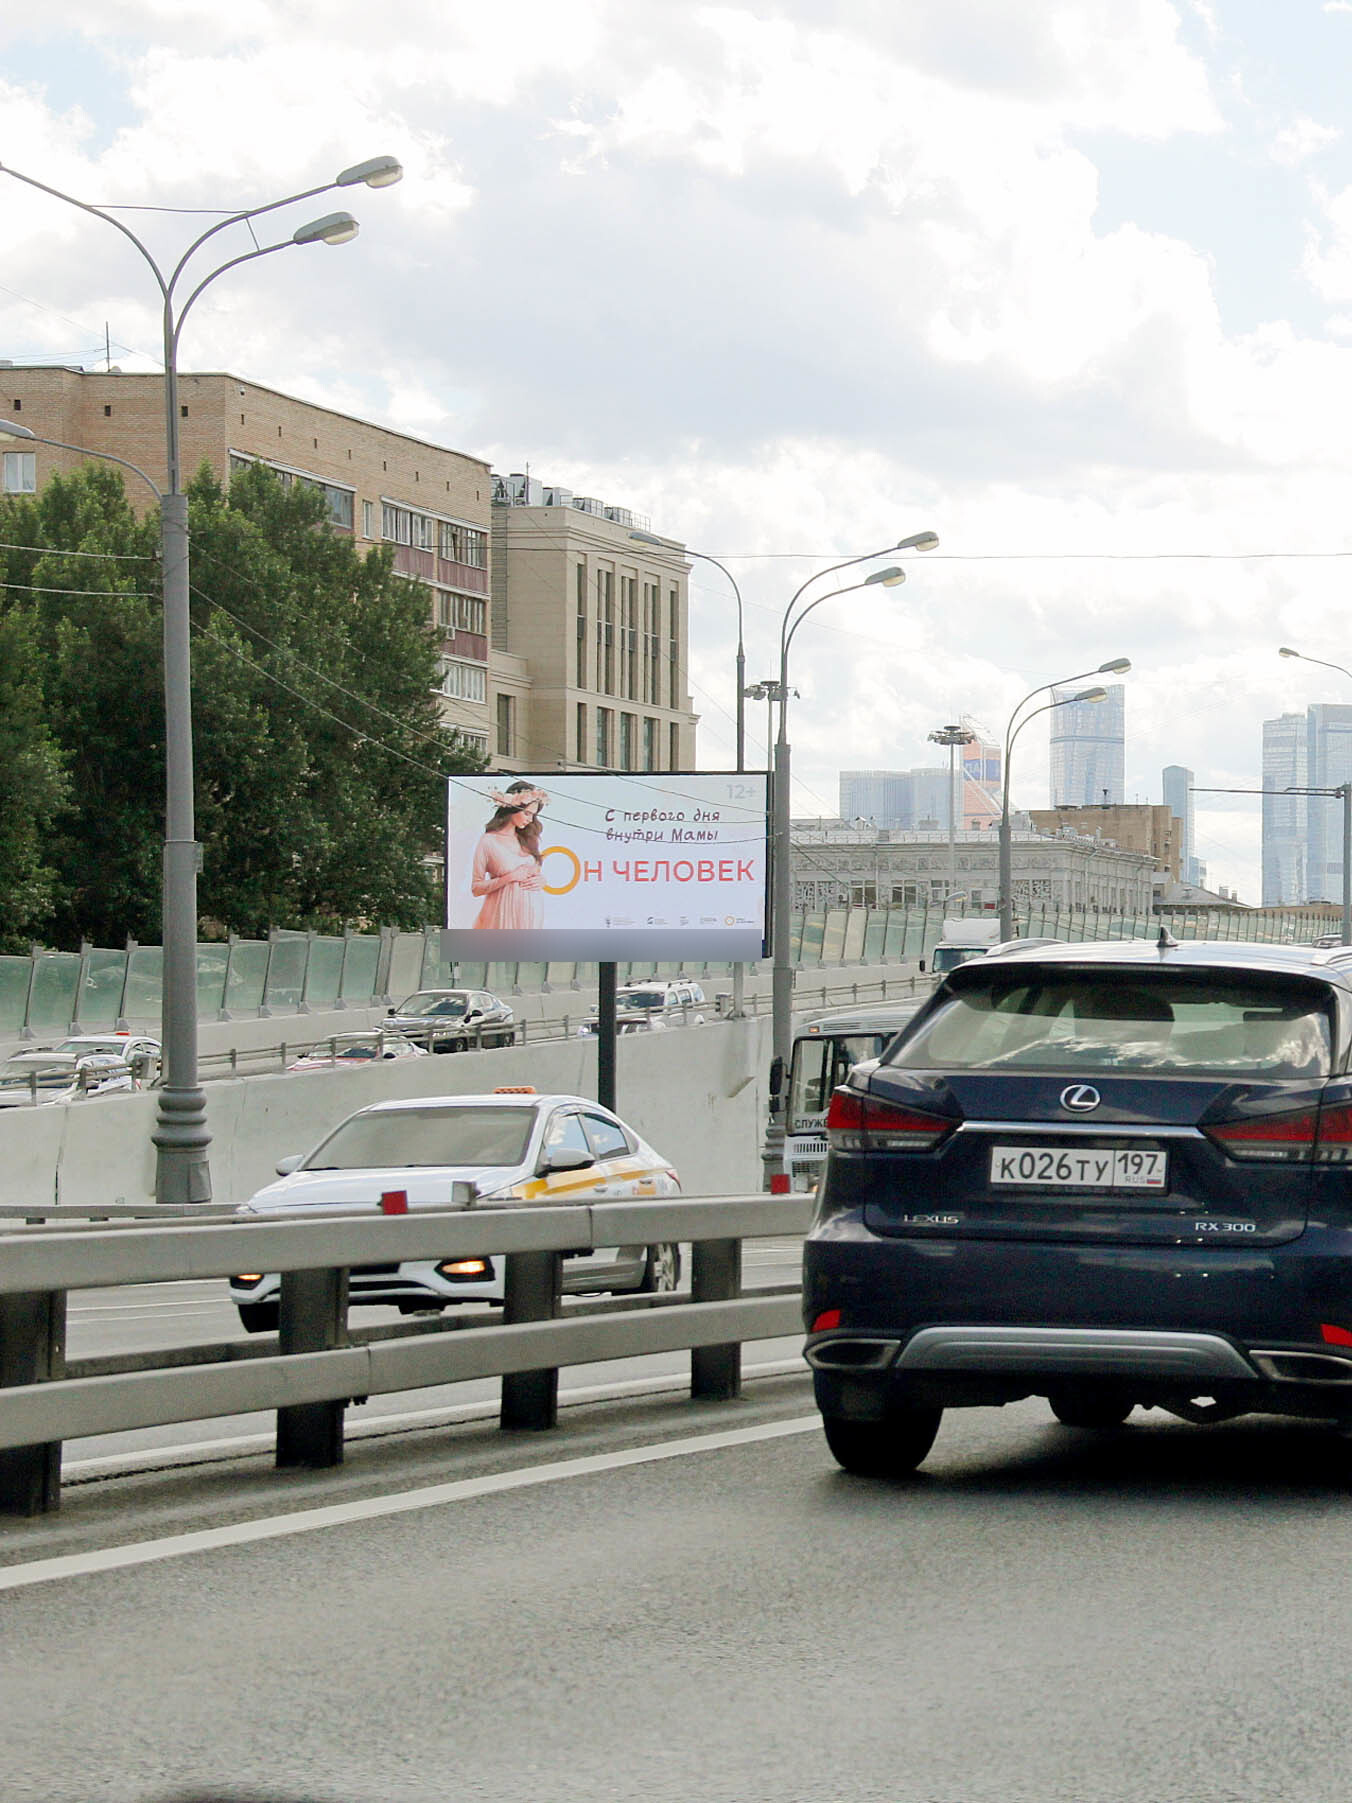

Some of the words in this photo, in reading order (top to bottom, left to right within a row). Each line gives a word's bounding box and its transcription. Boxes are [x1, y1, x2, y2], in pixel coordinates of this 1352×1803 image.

[726, 784, 757, 799] 12+
[605, 809, 616, 822] С
[624, 808, 685, 824] первого
[693, 808, 720, 822] дня
[606, 827, 664, 843] внутри
[672, 828, 719, 841] Мамы
[613, 859, 755, 882] ЧЕЛОВЕК
[1000, 1151, 1109, 1182] К026ТУ
[1117, 1153, 1159, 1175] 197
[1125, 1176, 1146, 1184] RUS
[904, 1214, 959, 1225] LEXUS
[1195, 1222, 1219, 1232] RX
[1222, 1222, 1256, 1233] 300
